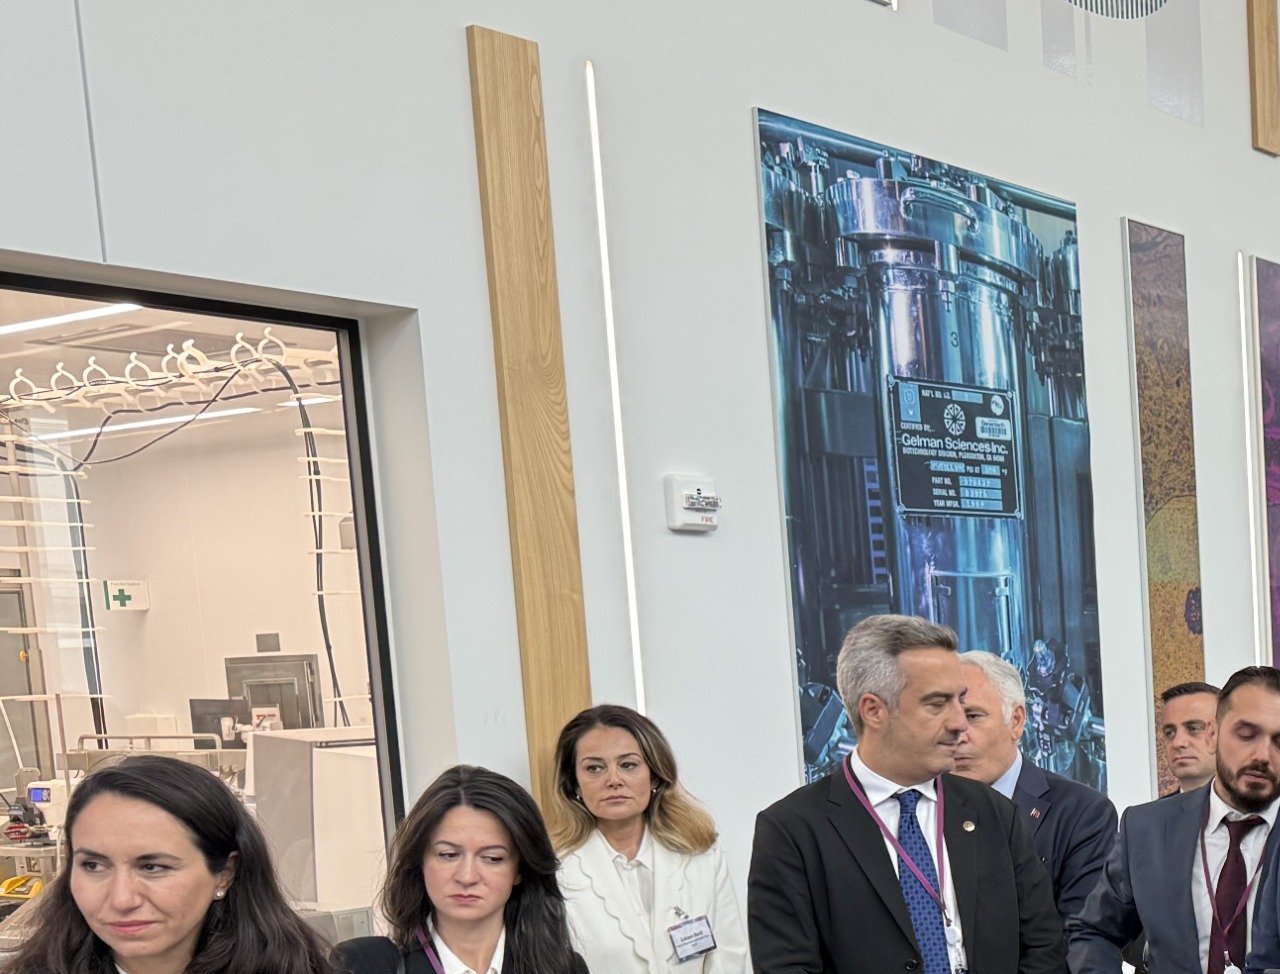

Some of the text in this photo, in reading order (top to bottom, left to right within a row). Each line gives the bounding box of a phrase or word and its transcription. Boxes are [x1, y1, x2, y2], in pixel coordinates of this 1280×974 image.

[950, 332, 958, 348] 3
[901, 434, 1008, 454] Gelman Sciences Inc.
